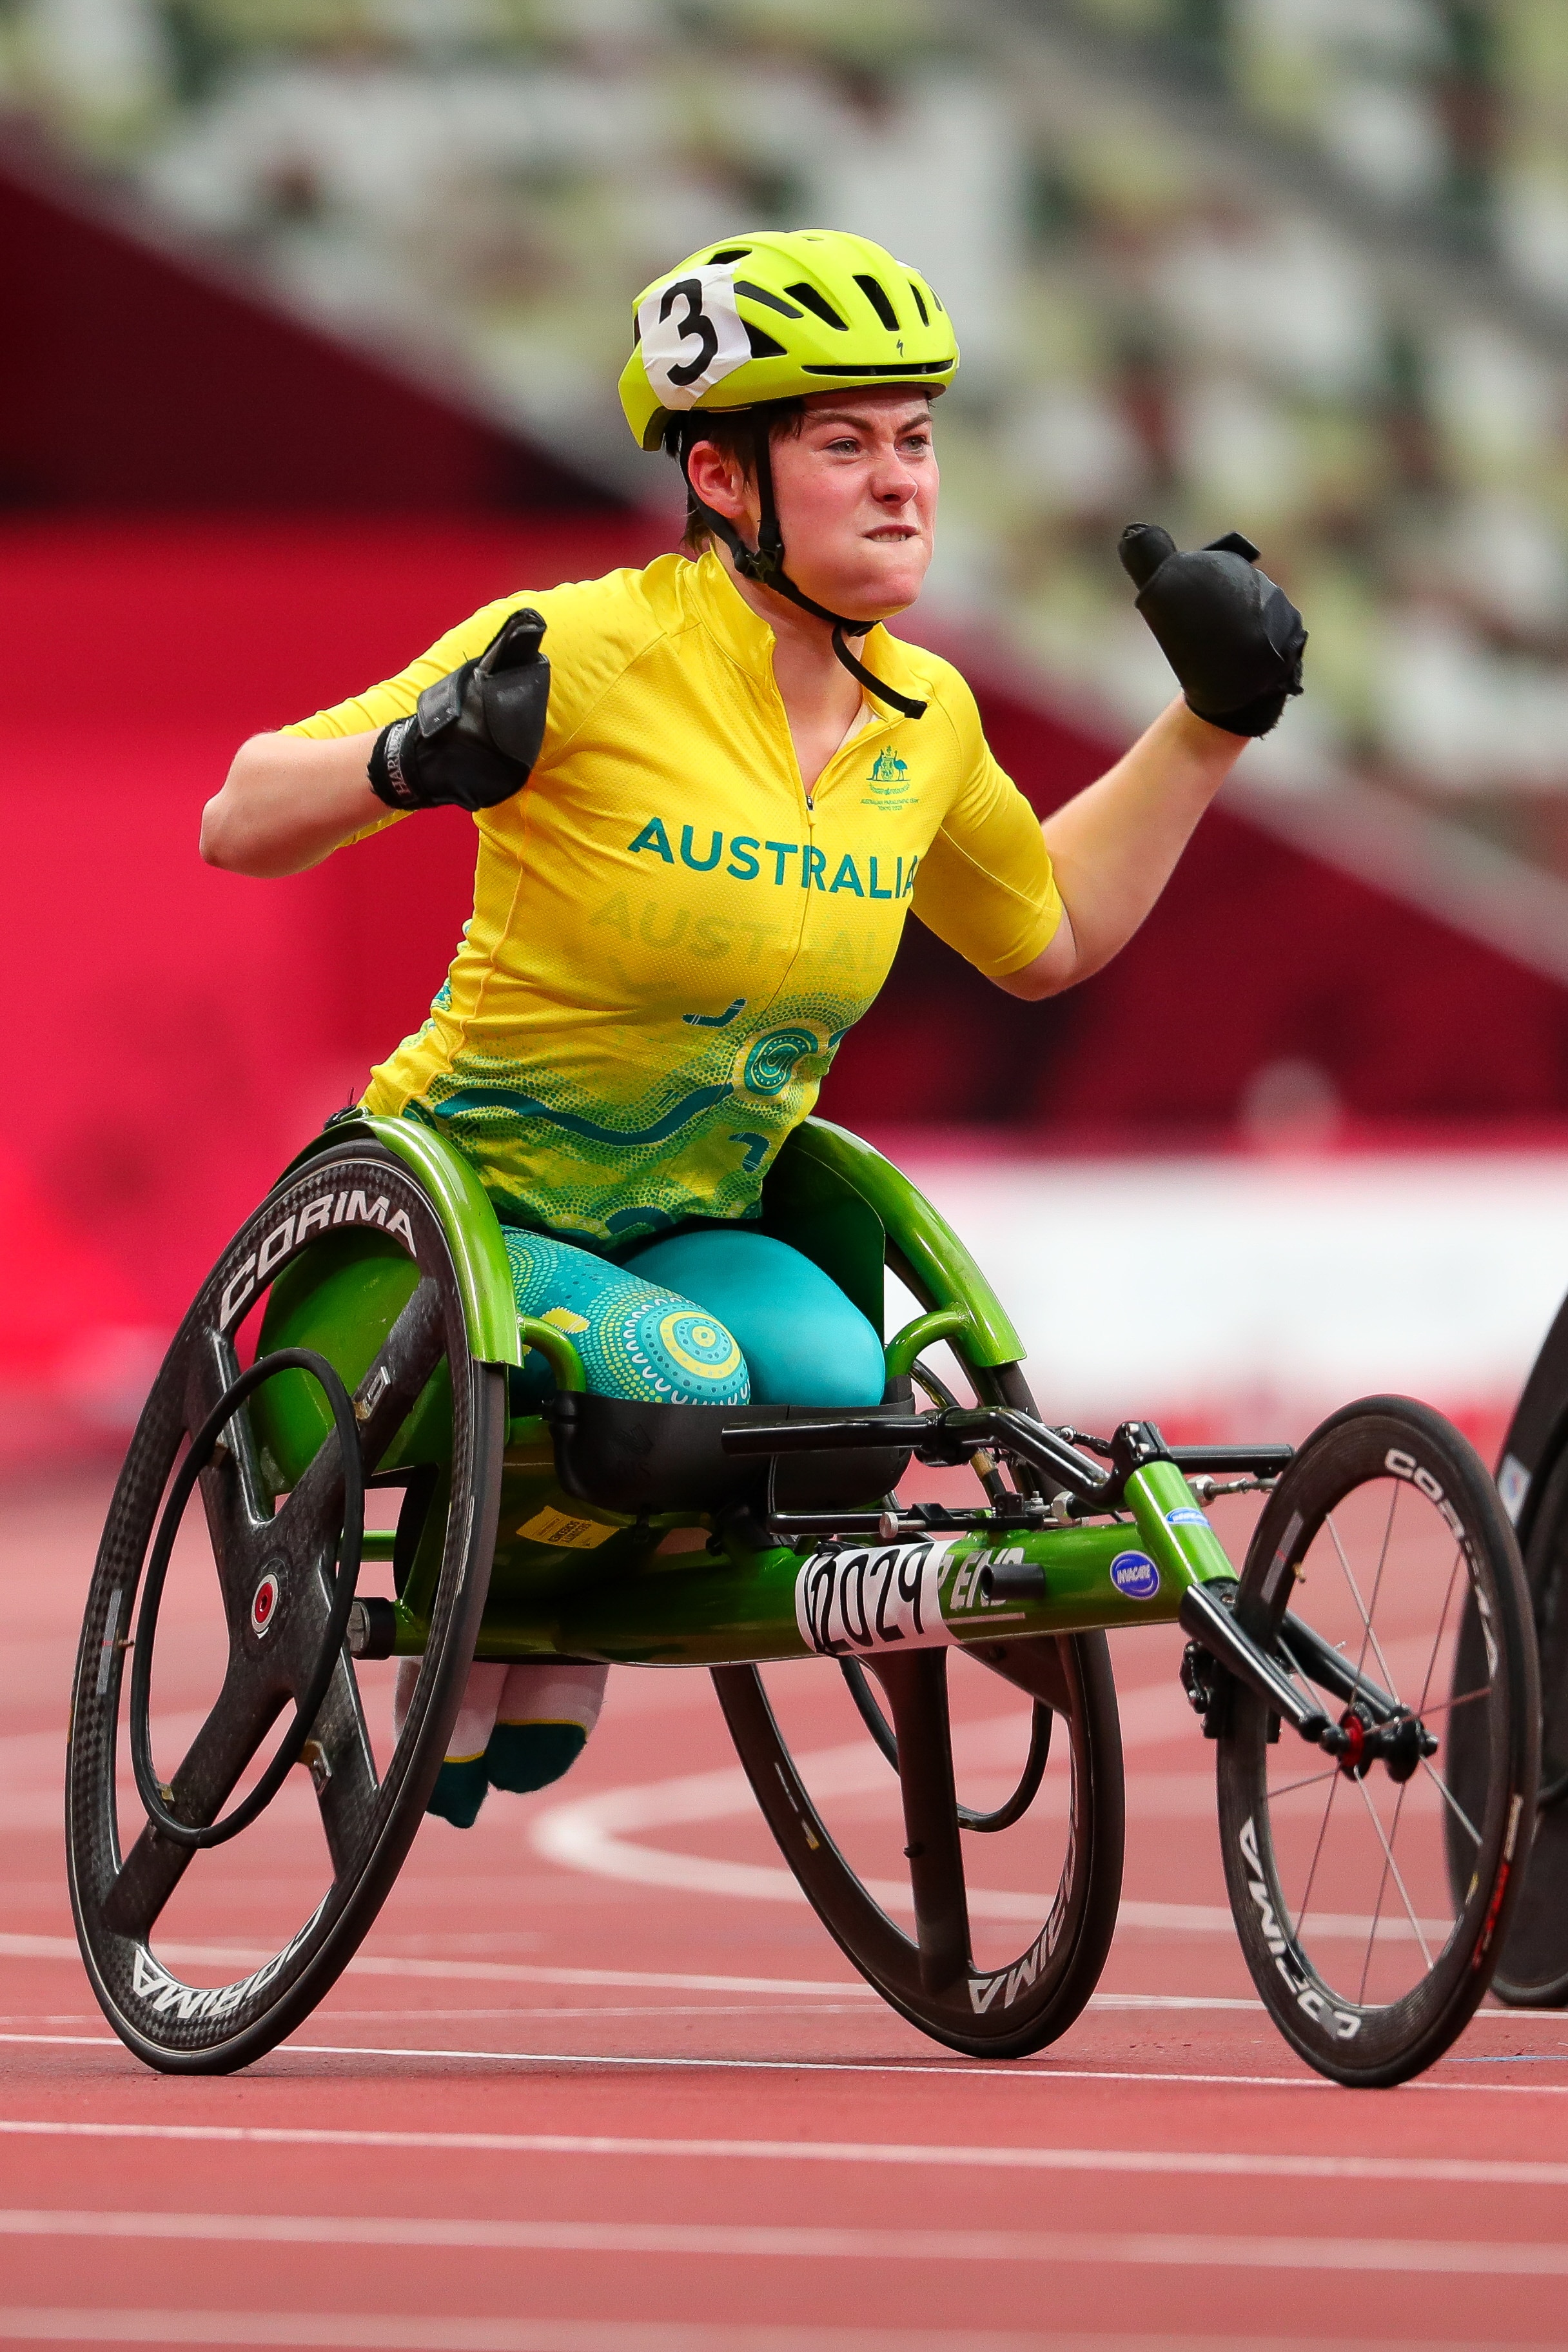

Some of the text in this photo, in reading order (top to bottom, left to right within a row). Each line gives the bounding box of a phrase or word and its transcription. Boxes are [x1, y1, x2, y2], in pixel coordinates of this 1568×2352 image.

[658, 278, 718, 386] 3
[627, 816, 918, 899] AUSTRALIA
[219, 1190, 417, 1332] CORIMA
[810, 1542, 936, 1654] 2029
[132, 1888, 331, 2019] CORIMA
